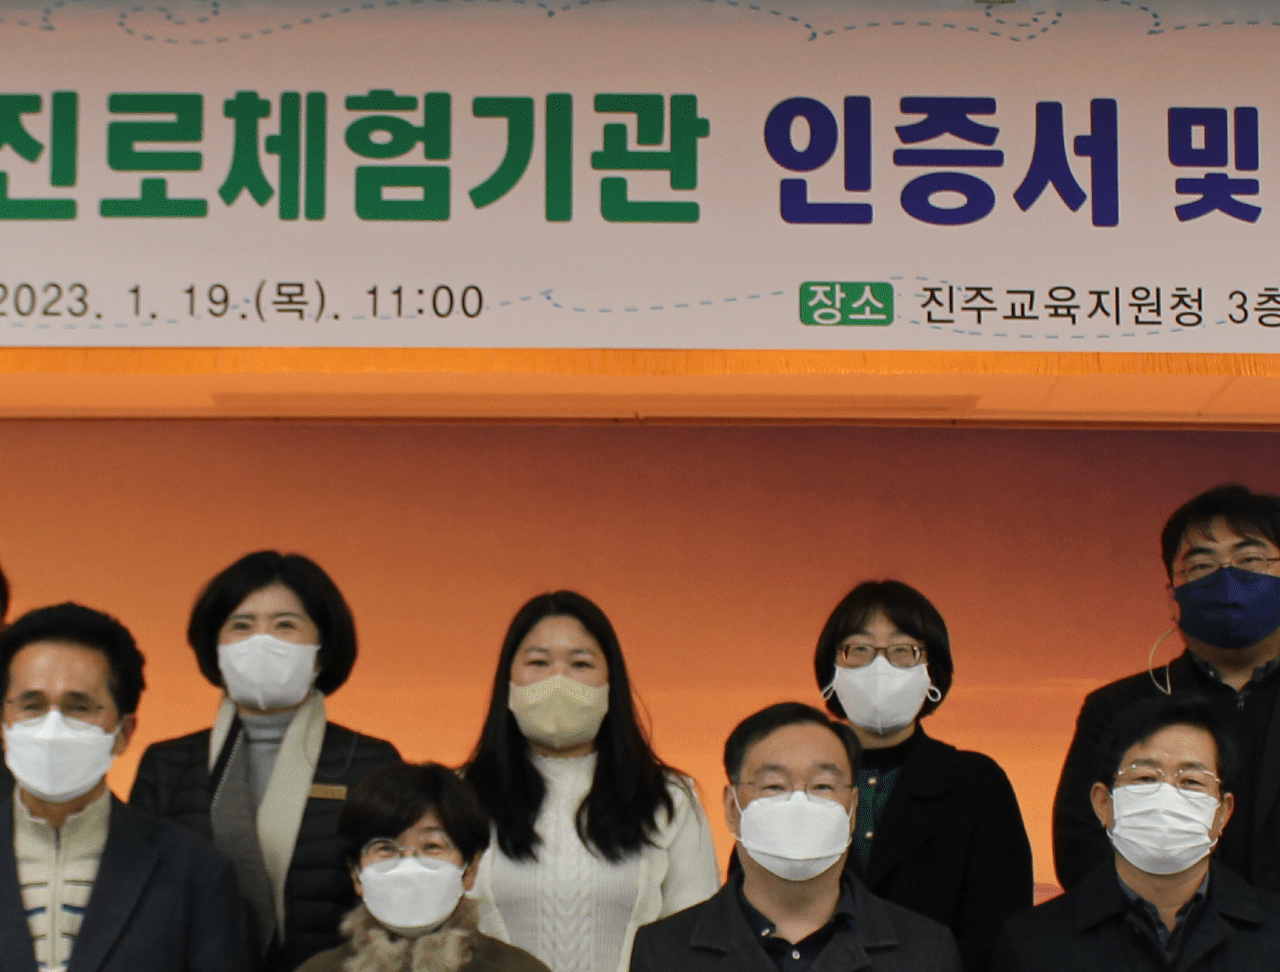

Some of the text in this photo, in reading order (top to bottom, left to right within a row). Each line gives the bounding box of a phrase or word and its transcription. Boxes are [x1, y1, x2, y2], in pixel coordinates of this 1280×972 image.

[765, 97, 1118, 226] 인증서
[1167, 107, 1261, 222] 및
[130, 285, 157, 319] 1.
[368, 285, 483, 318] 11:00
[808, 284, 886, 323] 장소
[922, 286, 1202, 326] 진주교육지원청
